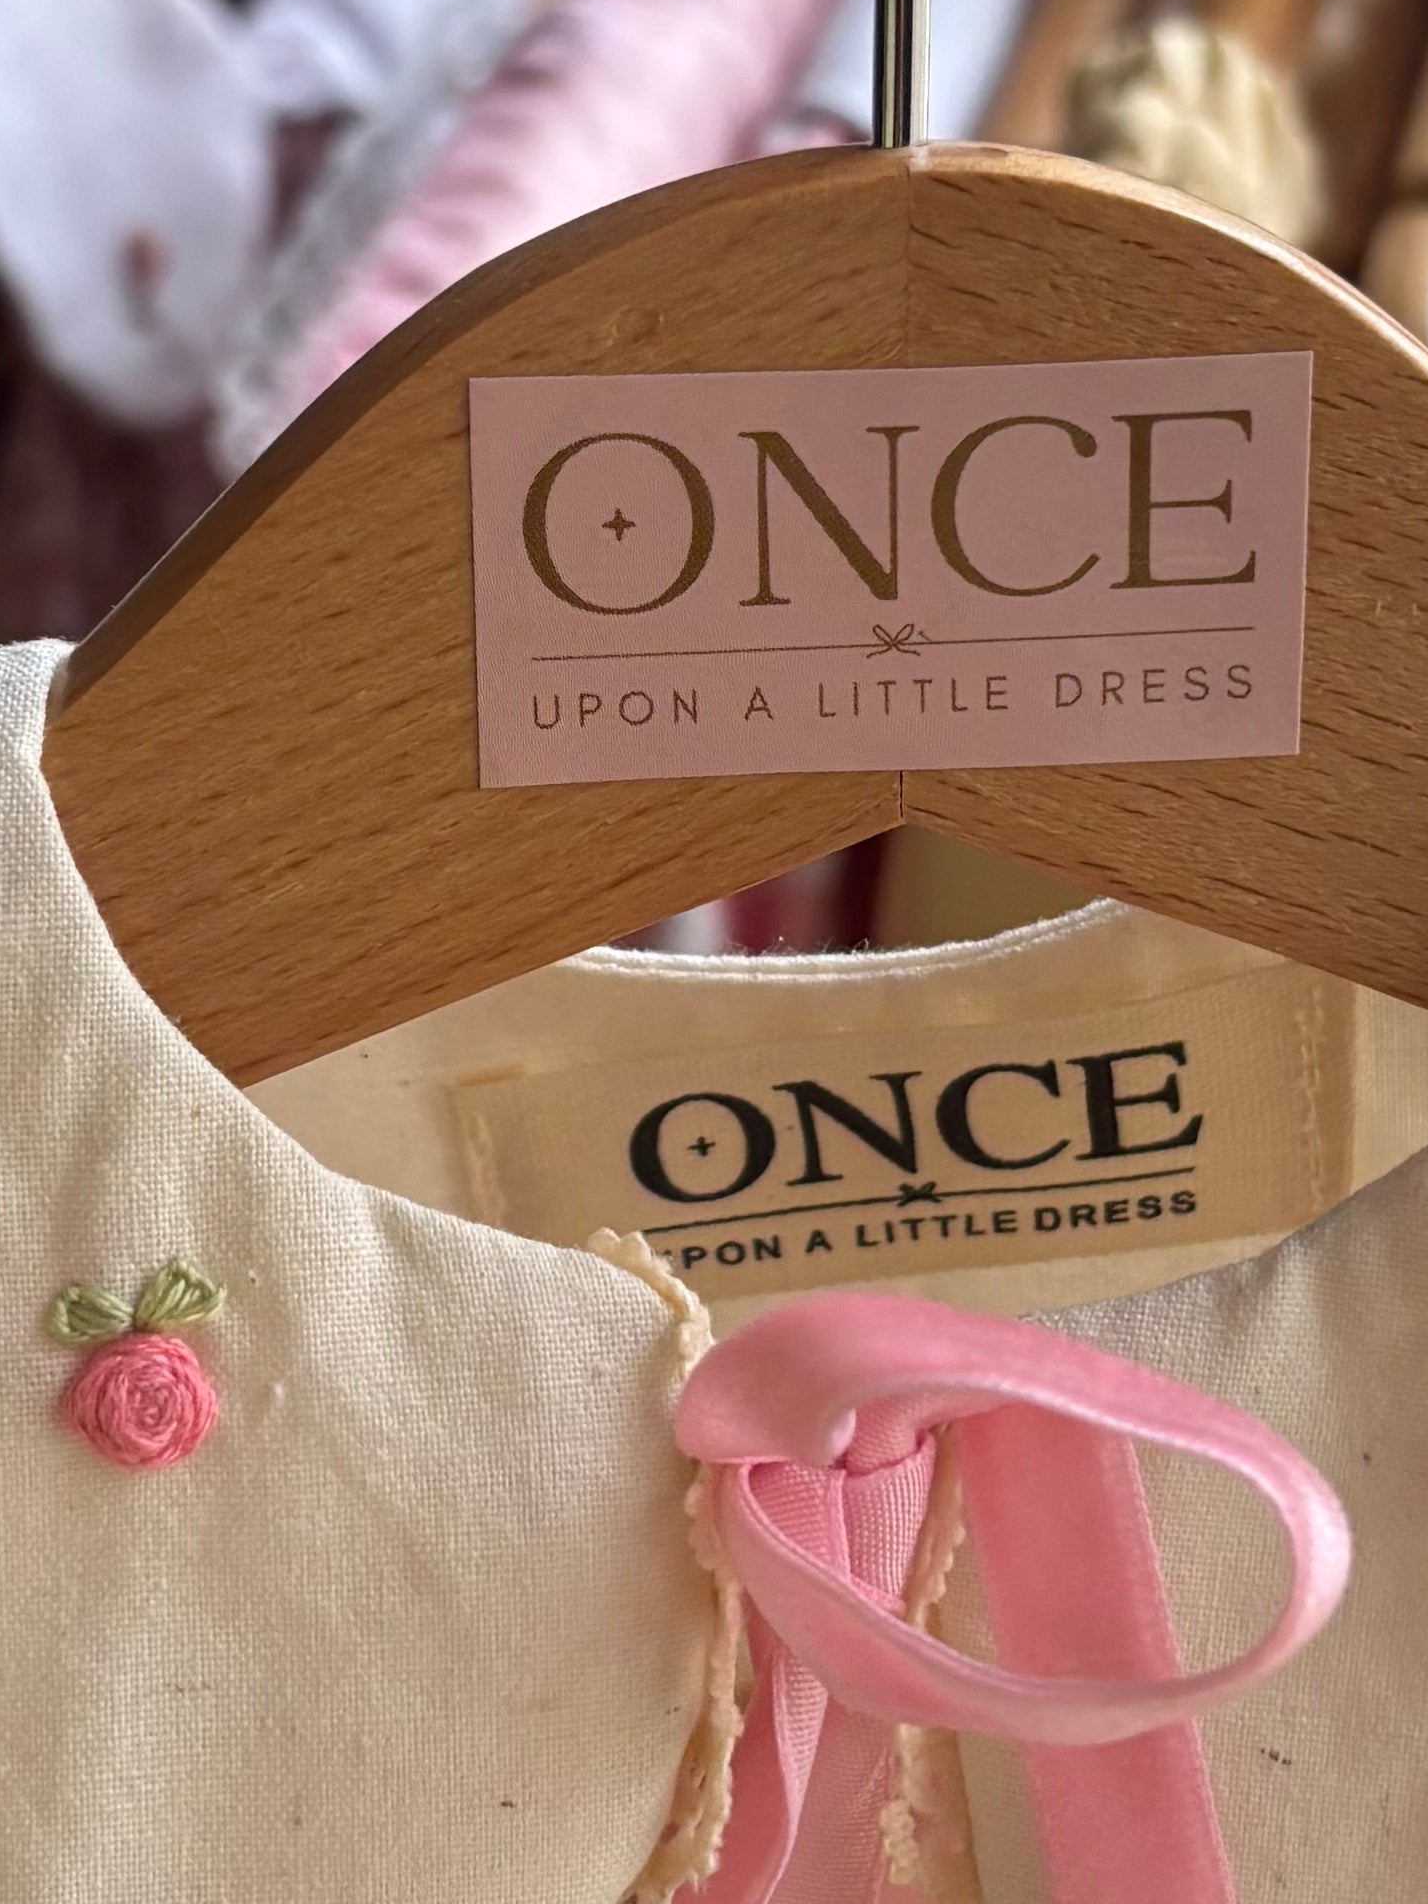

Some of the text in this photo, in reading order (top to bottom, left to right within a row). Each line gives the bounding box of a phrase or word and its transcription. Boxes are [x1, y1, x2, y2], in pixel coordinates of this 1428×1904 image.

[522, 409, 1256, 616] ONCE
[533, 665, 1255, 729] UPON A LITTLE DRESS
[629, 1040, 1203, 1203] ONCE
[661, 1191, 1197, 1271] PON A LITTLE DRESS
